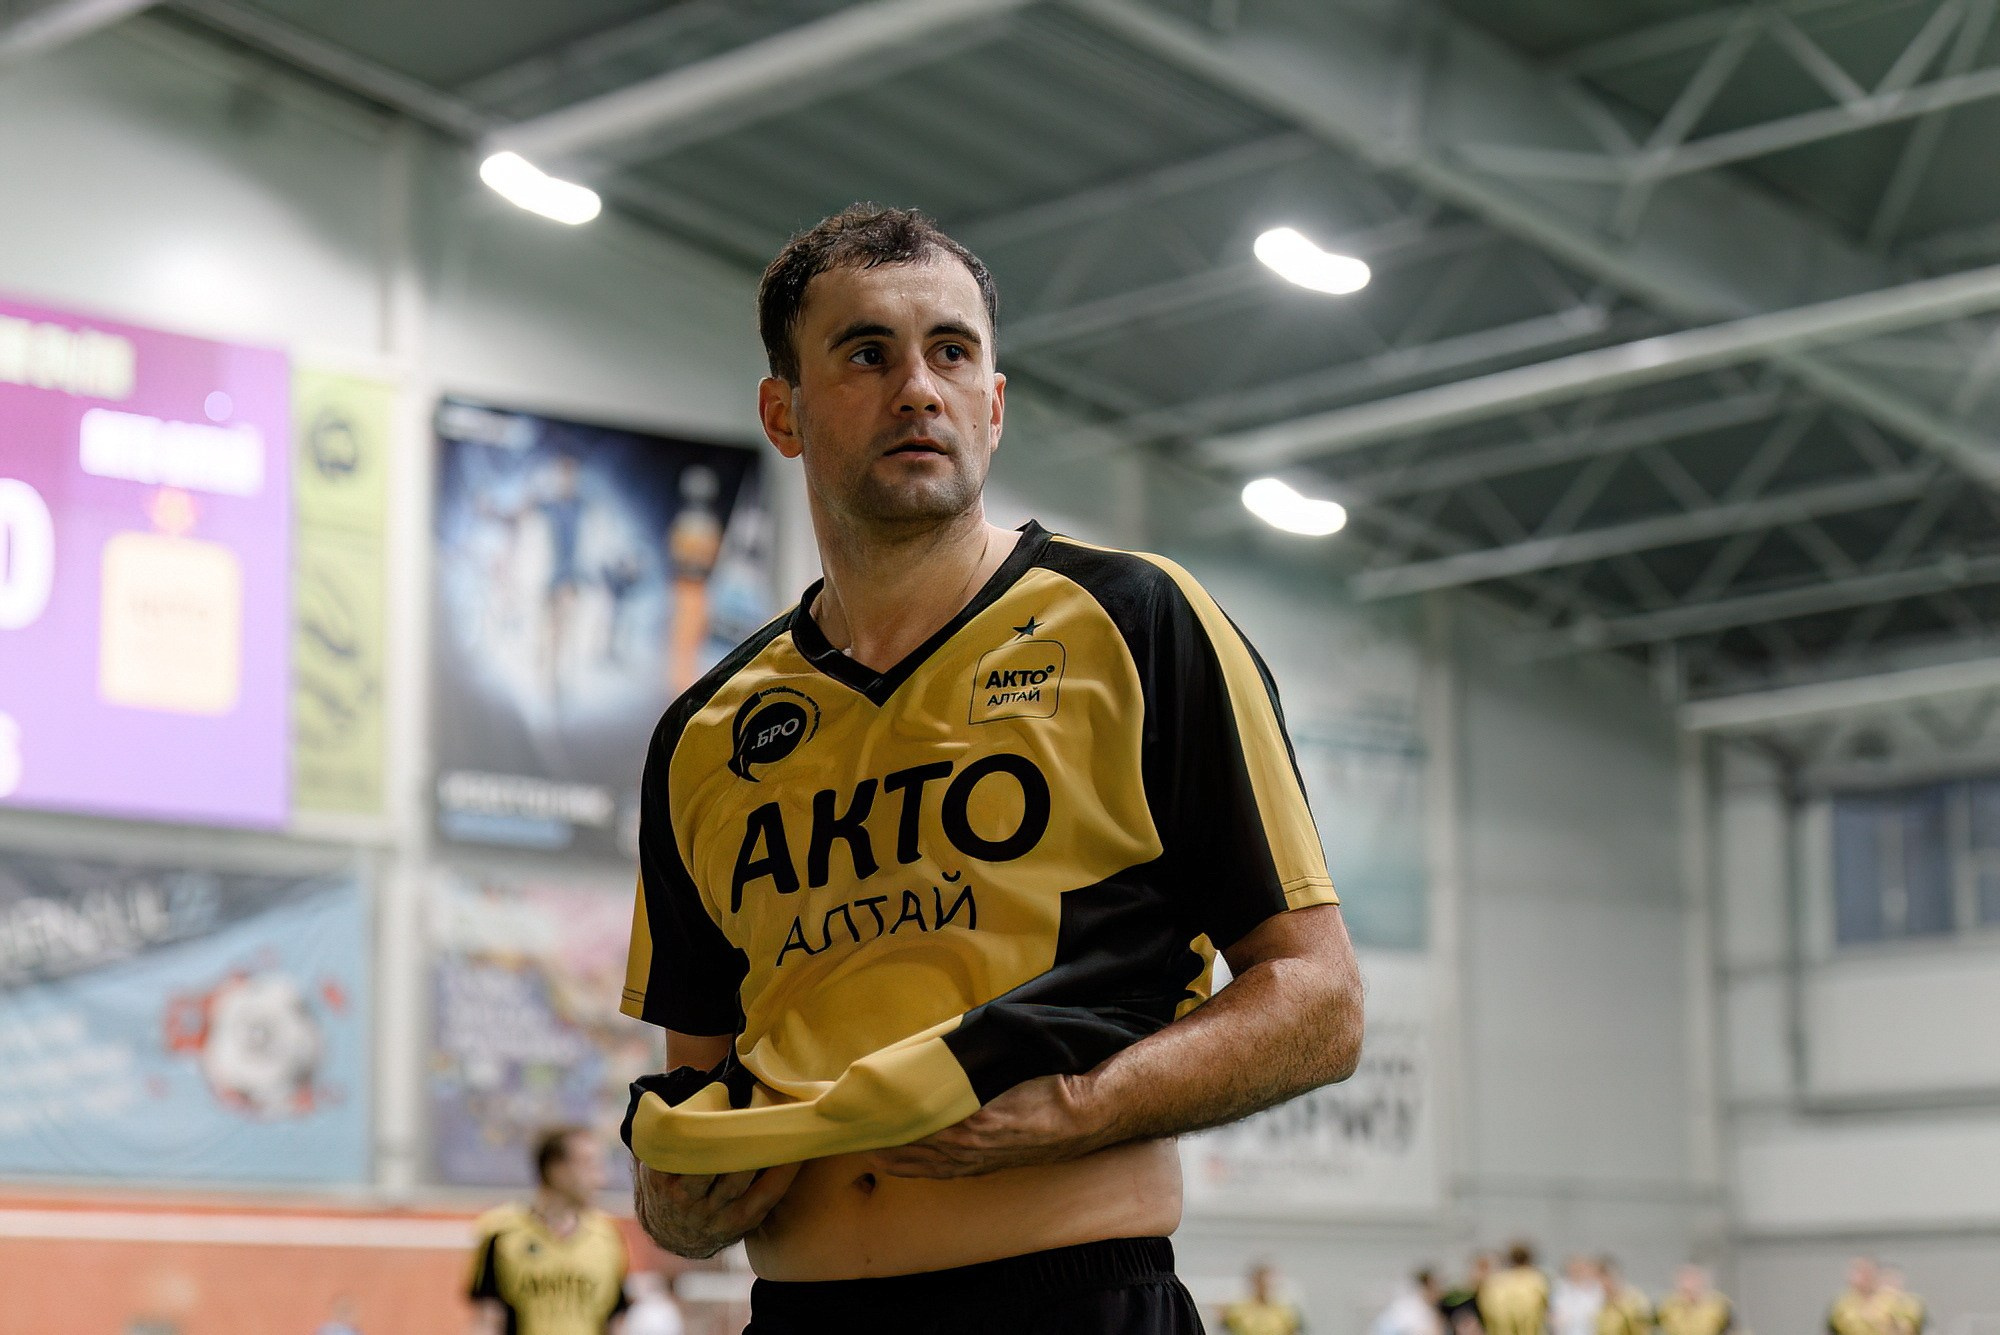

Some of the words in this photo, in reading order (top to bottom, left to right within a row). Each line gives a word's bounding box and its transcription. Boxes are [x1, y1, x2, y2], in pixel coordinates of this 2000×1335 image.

[985, 669, 1049, 690] АКТО
[986, 687, 1041, 707] АЛТАЙ
[730, 753, 1051, 914] АКТО
[776, 870, 977, 967] АЛТАЙ
